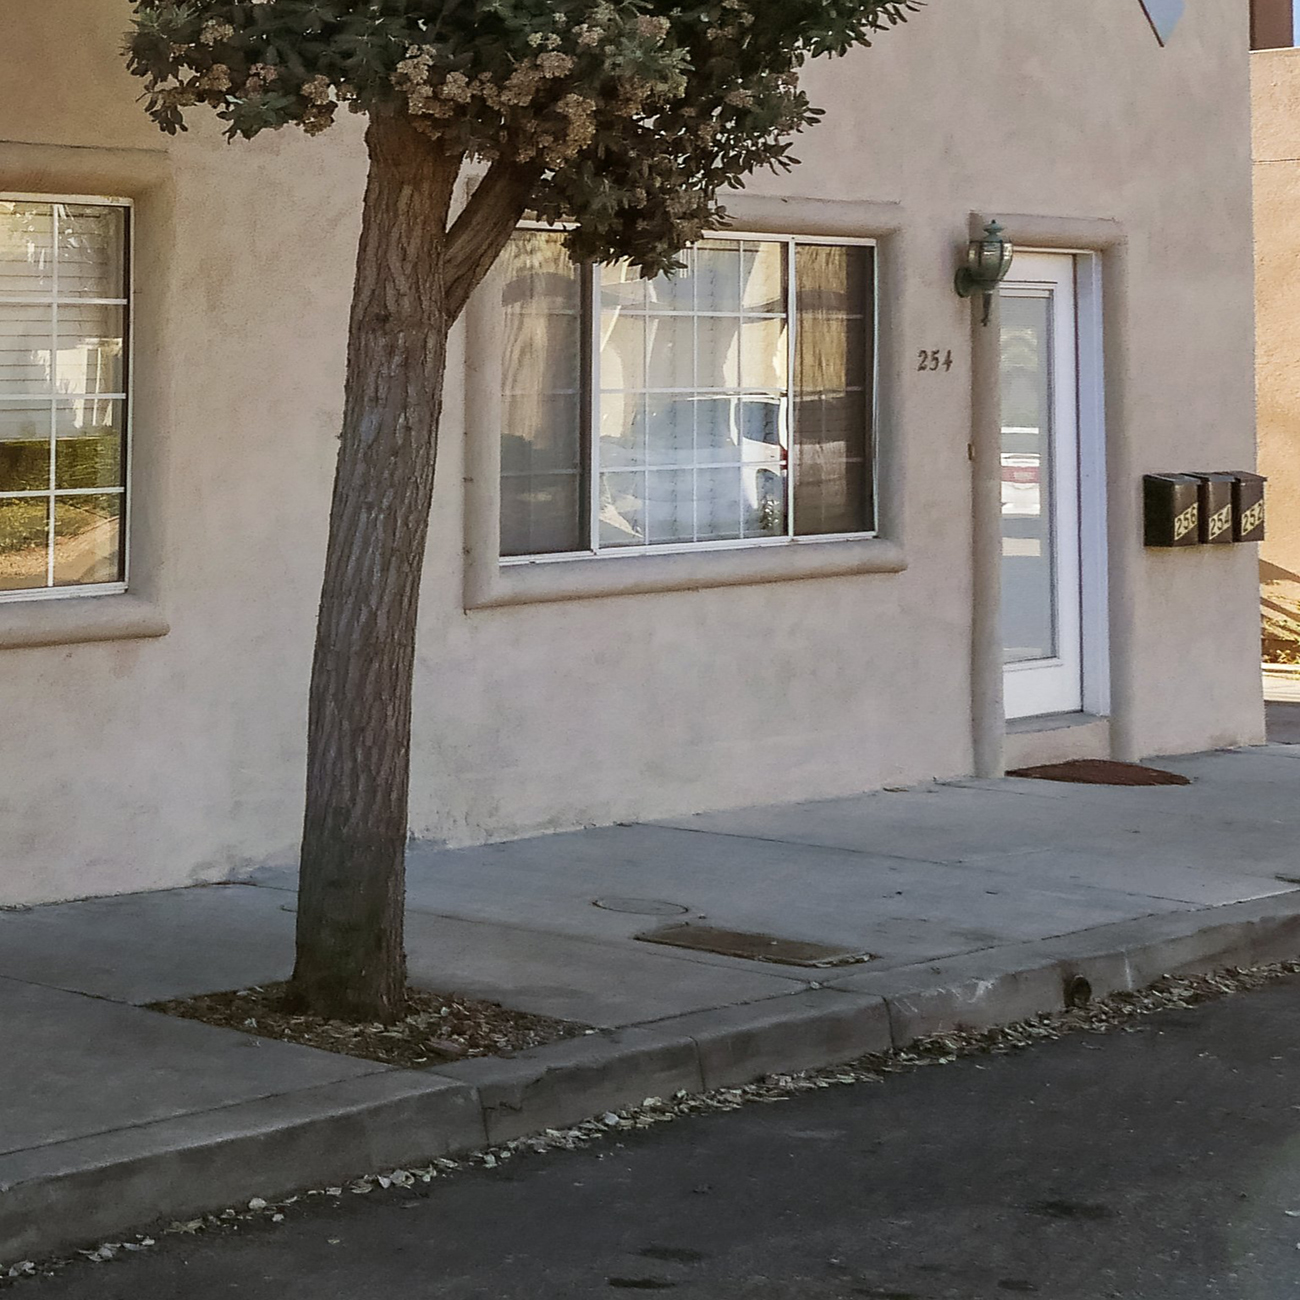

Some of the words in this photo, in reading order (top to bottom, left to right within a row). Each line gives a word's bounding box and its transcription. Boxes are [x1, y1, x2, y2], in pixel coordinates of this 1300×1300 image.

[917, 349, 953, 372] 254
[1176, 506, 1196, 537] 256
[1210, 506, 1230, 537] 254
[1243, 502, 1263, 533] 252
